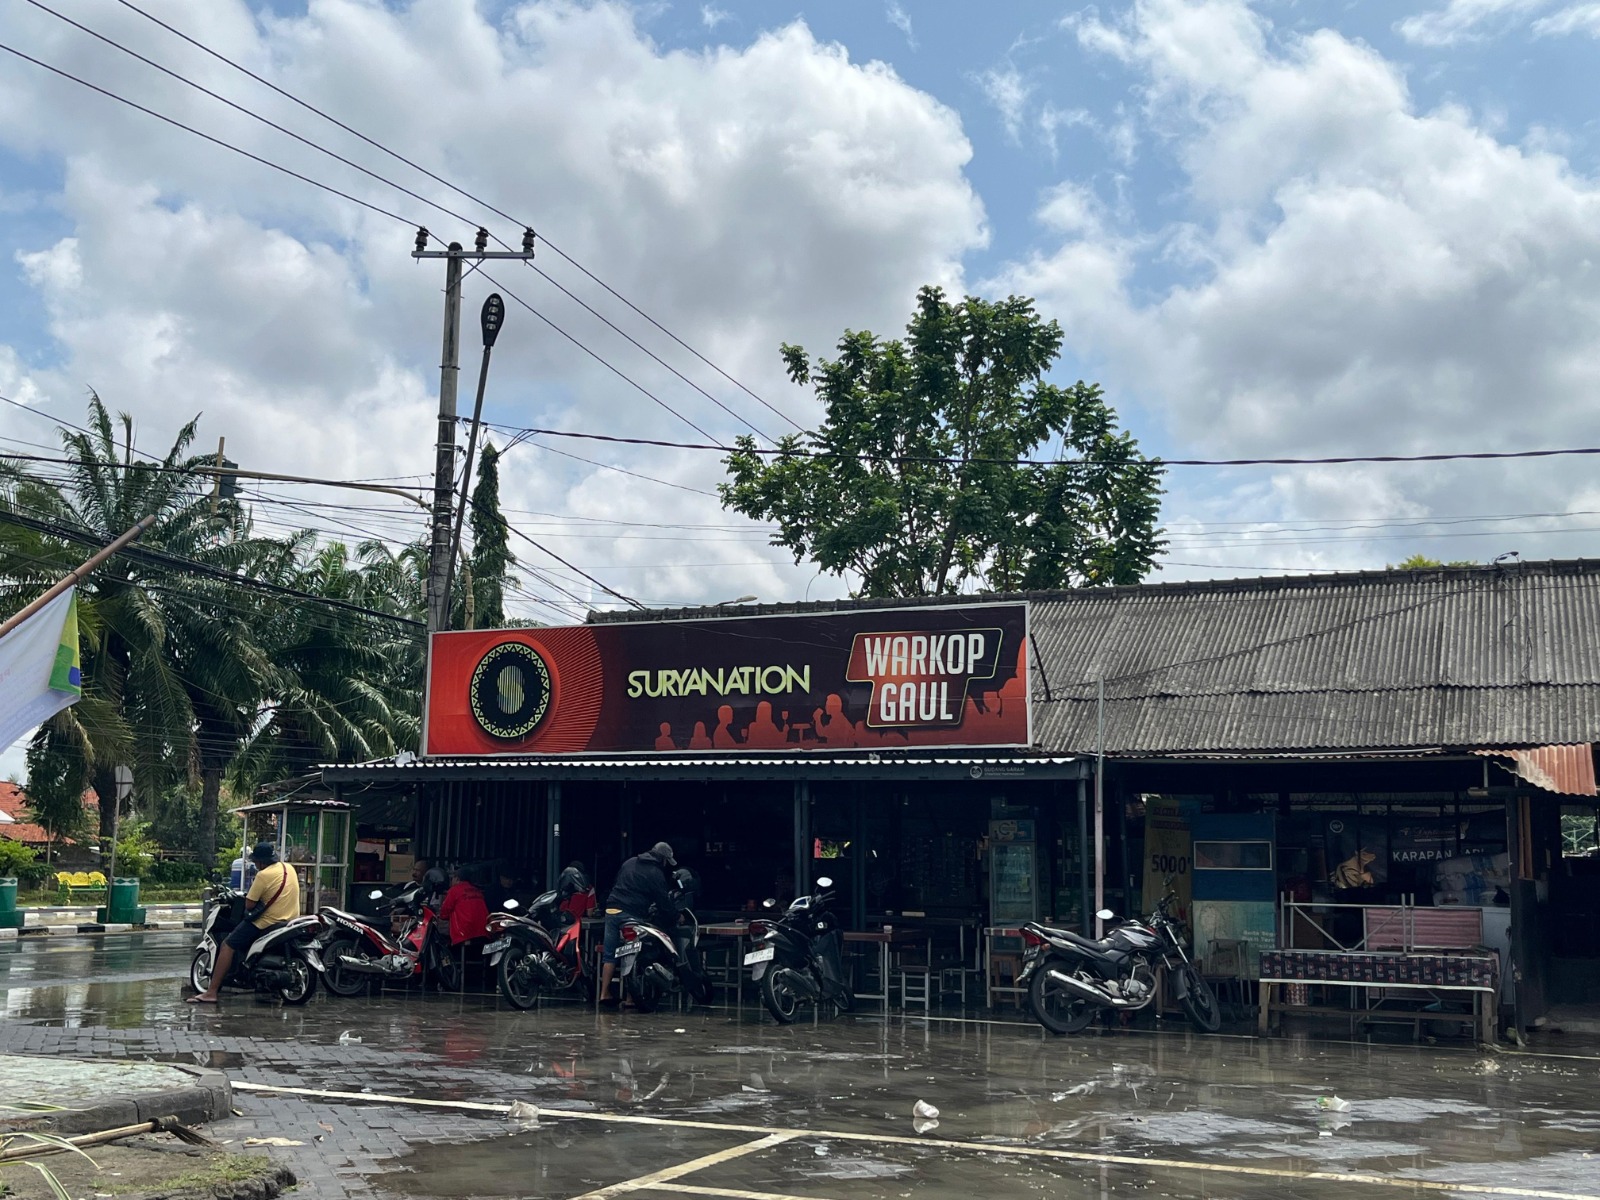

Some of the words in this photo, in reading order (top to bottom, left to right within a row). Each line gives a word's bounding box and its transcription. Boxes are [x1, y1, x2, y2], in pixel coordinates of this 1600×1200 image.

[864, 633, 985, 677] WARKOP
[627, 664, 811, 699] SURYANATION
[880, 681, 953, 721] GAUL
[1392, 849, 1453, 862] KARAPAN
[336, 916, 364, 936] HONDA
